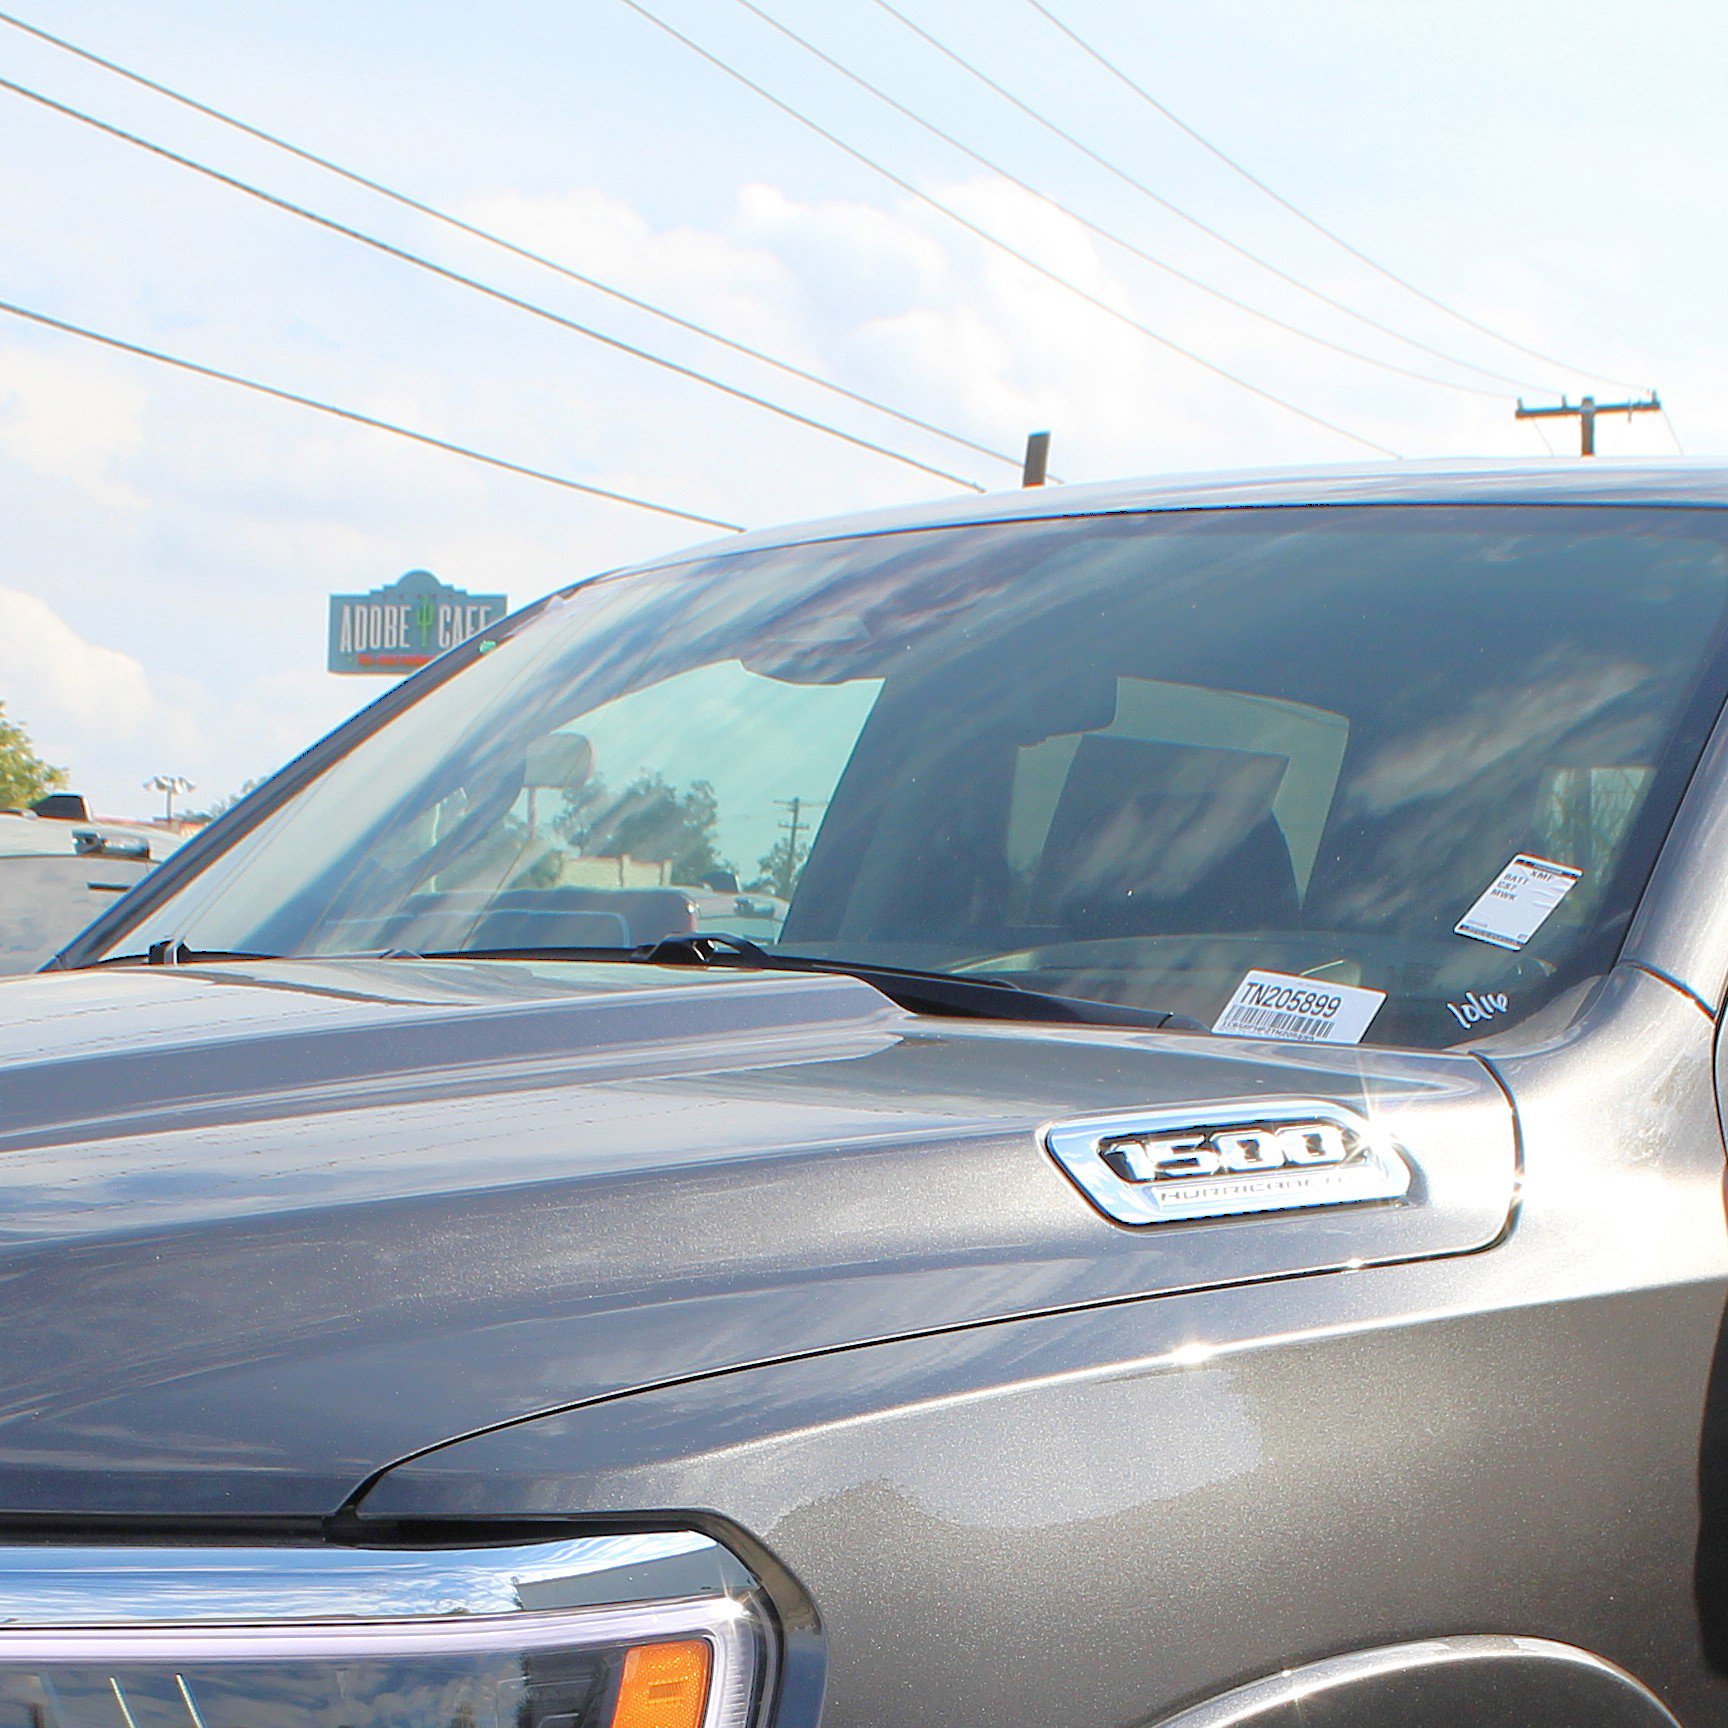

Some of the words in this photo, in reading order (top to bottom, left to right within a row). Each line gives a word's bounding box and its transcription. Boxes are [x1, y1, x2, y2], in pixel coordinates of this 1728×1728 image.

[340, 604, 413, 653] ADOBE
[1240, 981, 1342, 1018] TN205899
[1104, 1123, 1350, 1182] 1500
